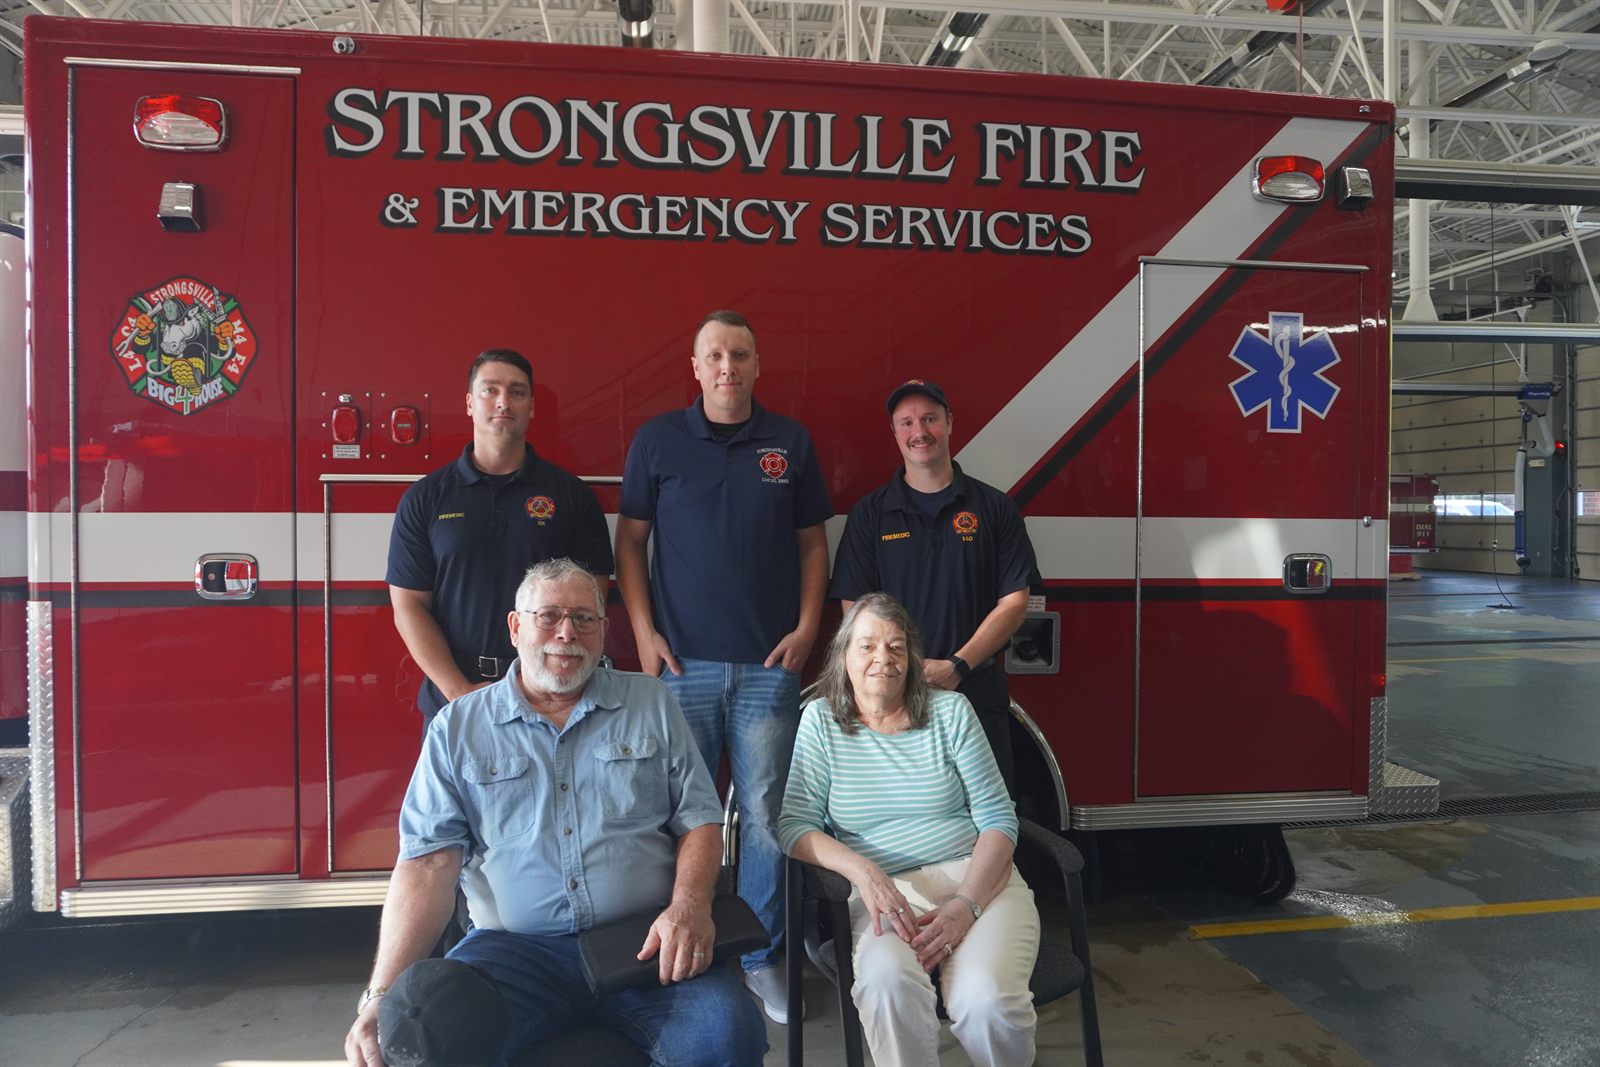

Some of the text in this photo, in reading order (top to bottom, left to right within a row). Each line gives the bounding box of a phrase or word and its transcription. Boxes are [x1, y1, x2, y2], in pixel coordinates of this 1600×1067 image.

[331, 87, 1146, 189] STRONGSVILLE FIRE
[383, 186, 1093, 254] & EMERGENCY SERVICES
[150, 281, 215, 308] STRONGSVILLE
[226, 352, 247, 374] E4
[147, 376, 224, 416] BIG 4 HOUSE
